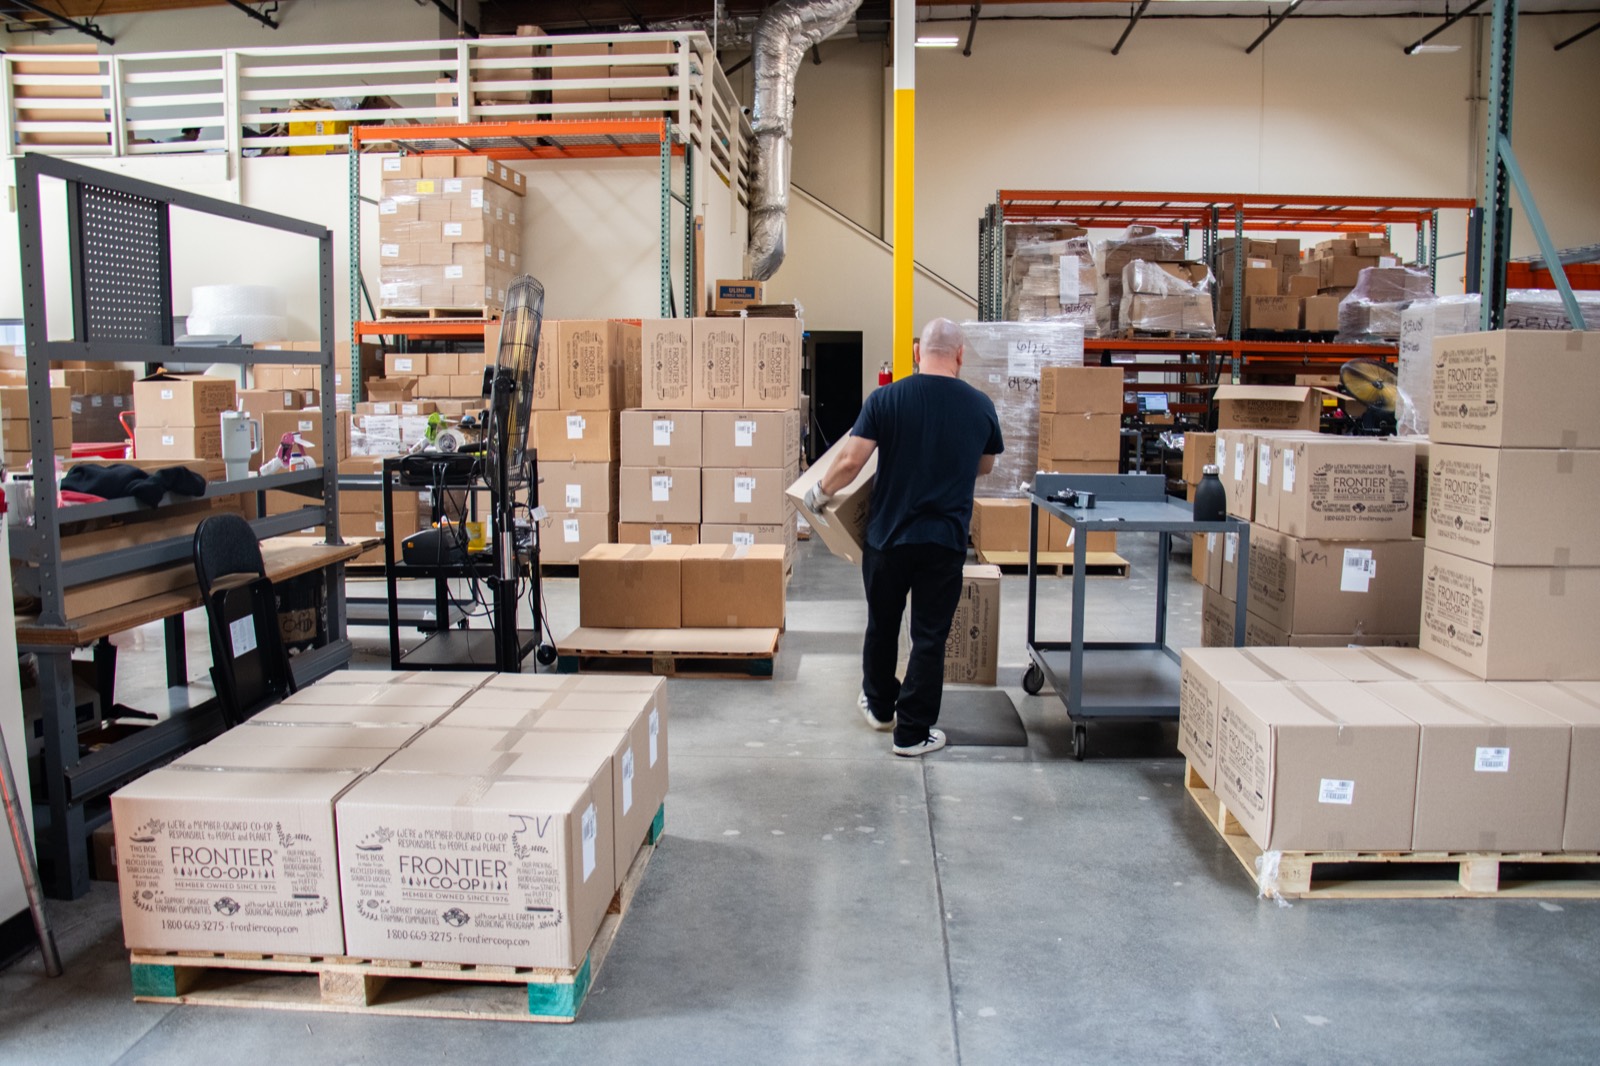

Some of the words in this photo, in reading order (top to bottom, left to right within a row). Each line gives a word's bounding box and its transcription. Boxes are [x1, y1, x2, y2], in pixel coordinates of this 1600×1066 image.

[1448, 366, 1482, 382] FRONTIER
[1456, 382, 1473, 392] CO-OP
[1334, 476, 1386, 488] FRONTIER
[1444, 478, 1477, 496] FRONTIER
[1348, 486, 1372, 494] CO-OP
[1301, 548, 1328, 567] KM
[1438, 584, 1470, 608] FRONTIER
[1229, 729, 1254, 762] FRONTIER
[167, 820, 186, 830] WE'RE
[193, 820, 248, 831] MEMBER-OWNED
[250, 822, 273, 832] CO-OP
[168, 830, 205, 840] RESPONSIBLE
[216, 831, 236, 840] PEOPLE
[397, 829, 416, 838] WE'RE
[424, 830, 482, 842] MEMBER-OWNED
[484, 832, 508, 842] CO-OP
[130, 844, 141, 853] THIS
[398, 839, 436, 850] RESPONSIBLE
[447, 840, 468, 852] PEOPLE
[470, 843, 482, 852] and
[171, 846, 274, 868] FRONTIER
[356, 853, 369, 861] THIS
[371, 854, 384, 862] BOX
[400, 855, 507, 878] FRONTIER
[200, 866, 248, 880] CO-OP
[430, 876, 480, 891] CO-OP
[164, 897, 185, 905] SUPPORT
[436, 892, 464, 900] OWNED
[178, 906, 212, 915] COMMUNITIES
[244, 907, 274, 917] SOURCING
[390, 906, 412, 914] SUPPORT
[414, 907, 438, 916] ORGANIC
[380, 914, 402, 923] FARMING
[404, 914, 440, 926] COMMUNITIES
[498, 913, 515, 921] WELL
[230, 922, 299, 936] frontiercoop.com
[474, 920, 504, 930] SOURCING
[458, 932, 530, 949] frontiercoop.com
